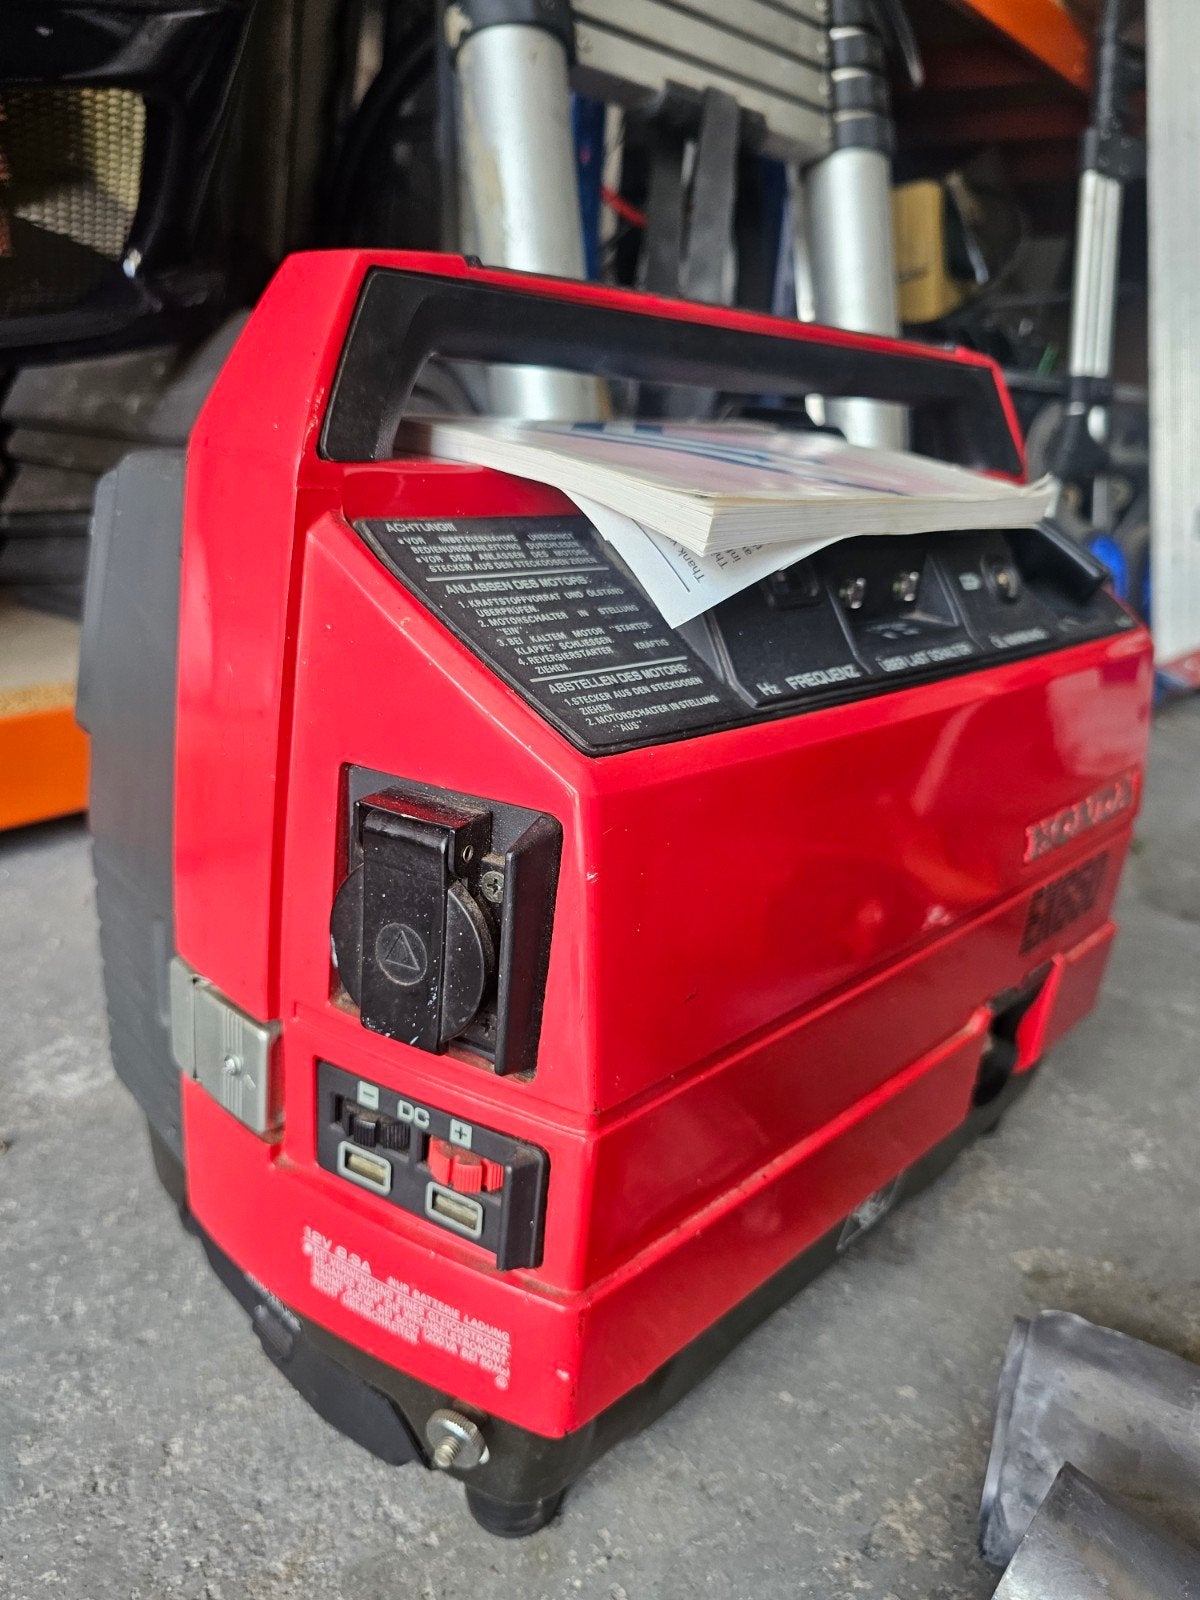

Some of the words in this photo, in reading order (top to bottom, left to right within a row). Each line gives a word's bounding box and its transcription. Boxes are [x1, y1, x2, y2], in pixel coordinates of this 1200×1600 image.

[403, 536, 427, 545] VOR
[421, 555, 444, 564] VOR
[448, 553, 473, 563] DEM
[478, 551, 526, 561] ANLASSEN
[529, 550, 550, 559] DES
[552, 549, 590, 557] MOTORS
[678, 547, 705, 583] Thank
[428, 563, 474, 573] STECKER
[473, 562, 494, 571] AUS
[493, 561, 514, 570] DEN
[513, 559, 571, 568] STECKDOSEN
[445, 582, 514, 595] ANLASSEN
[511, 579, 540, 590] DES
[537, 576, 592, 588] MOTORS:
[563, 591, 584, 600] UND
[576, 609, 590, 618] IN
[597, 604, 640, 615] STELLUNG
[529, 631, 568, 644] KALTEM
[571, 627, 606, 639] MOTOR
[534, 663, 572, 675] ZIEHEN.
[548, 674, 620, 695] ABSTELLEN
[615, 670, 643, 683] DES
[640, 663, 692, 680] MOTORS:
[612, 688, 632, 699] AUS
[631, 685, 652, 696] DEN
[650, 676, 704, 693] STECKDOSEN
[755, 681, 782, 696] Hz
[784, 663, 863, 690] FREQUENZ
[578, 703, 616, 716] ZIEHEN.
[668, 701, 681, 711] IN
[679, 694, 720, 710] STELLUNG
[396, 1099, 431, 1130] DC
[304, 1225, 332, 1251] 12V
[463, 1314, 509, 1344] LADUNG
